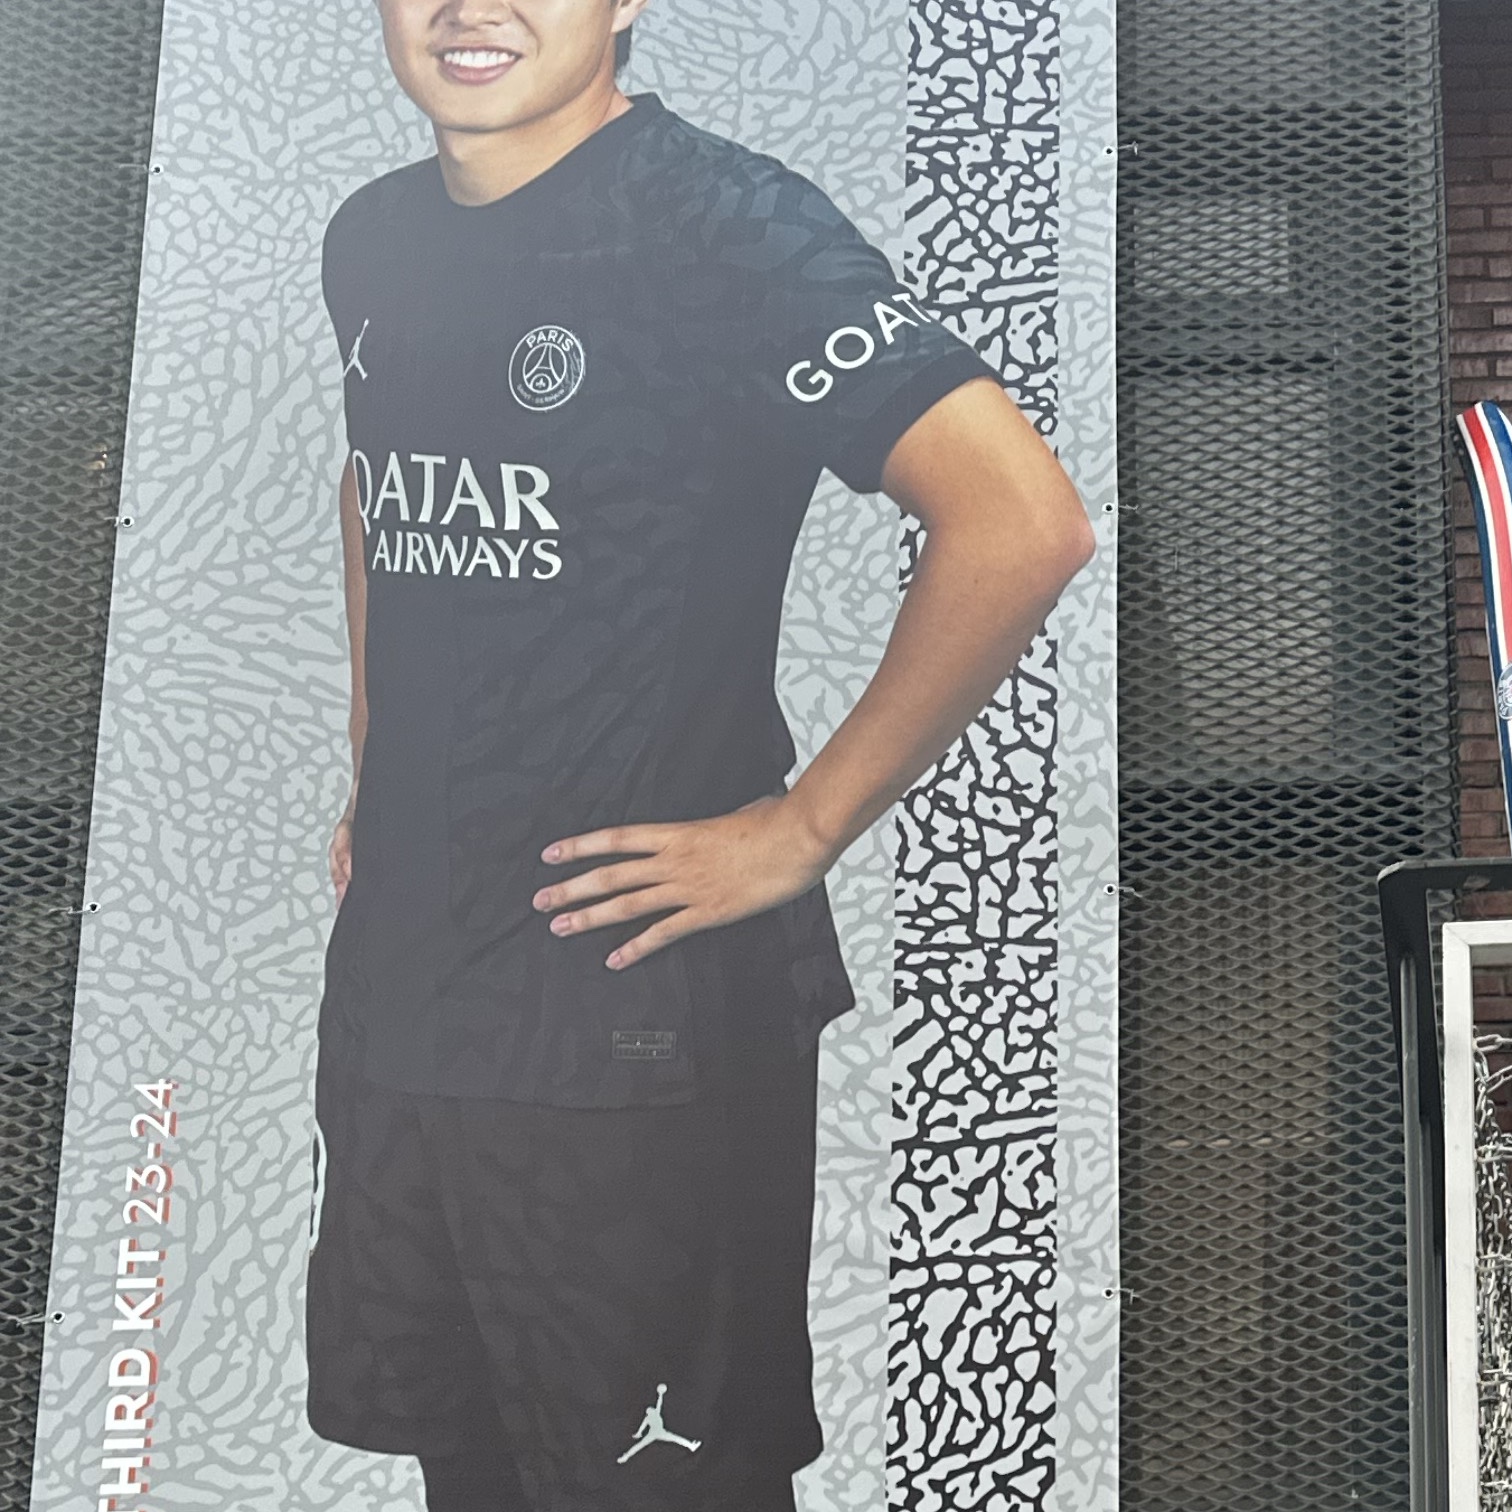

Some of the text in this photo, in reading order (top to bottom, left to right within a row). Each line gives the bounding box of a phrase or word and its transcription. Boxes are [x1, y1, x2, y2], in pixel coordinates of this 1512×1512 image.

[526, 330, 574, 351] PARIS
[352, 449, 560, 536] QATAR
[372, 529, 562, 580] AIRWAYS
[122, 1078, 179, 1225] 23-24
[112, 1239, 166, 1330] KIT
